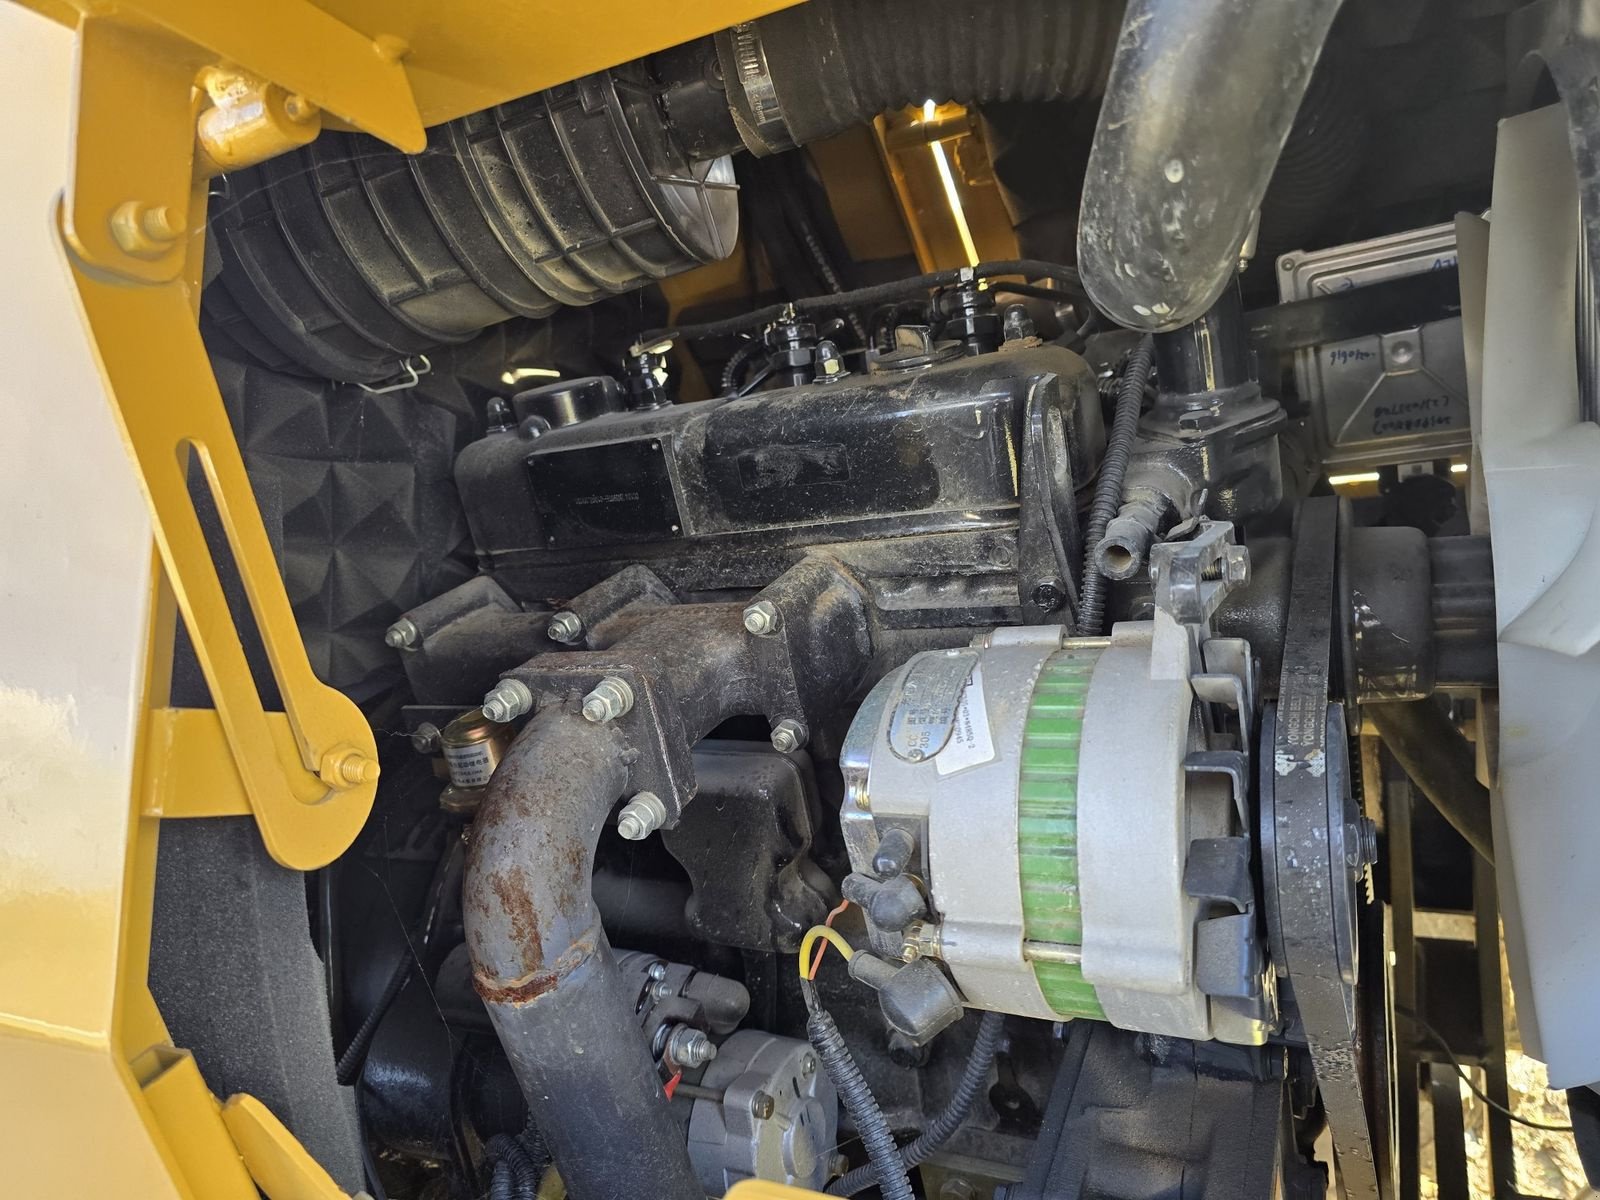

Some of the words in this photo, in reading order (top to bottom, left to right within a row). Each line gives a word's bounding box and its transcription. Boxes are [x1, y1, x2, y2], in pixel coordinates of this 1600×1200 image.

[920, 731, 931, 749] 305
[1288, 711, 1300, 746] YONGCHI
[1303, 711, 1315, 747] YONGCHI
